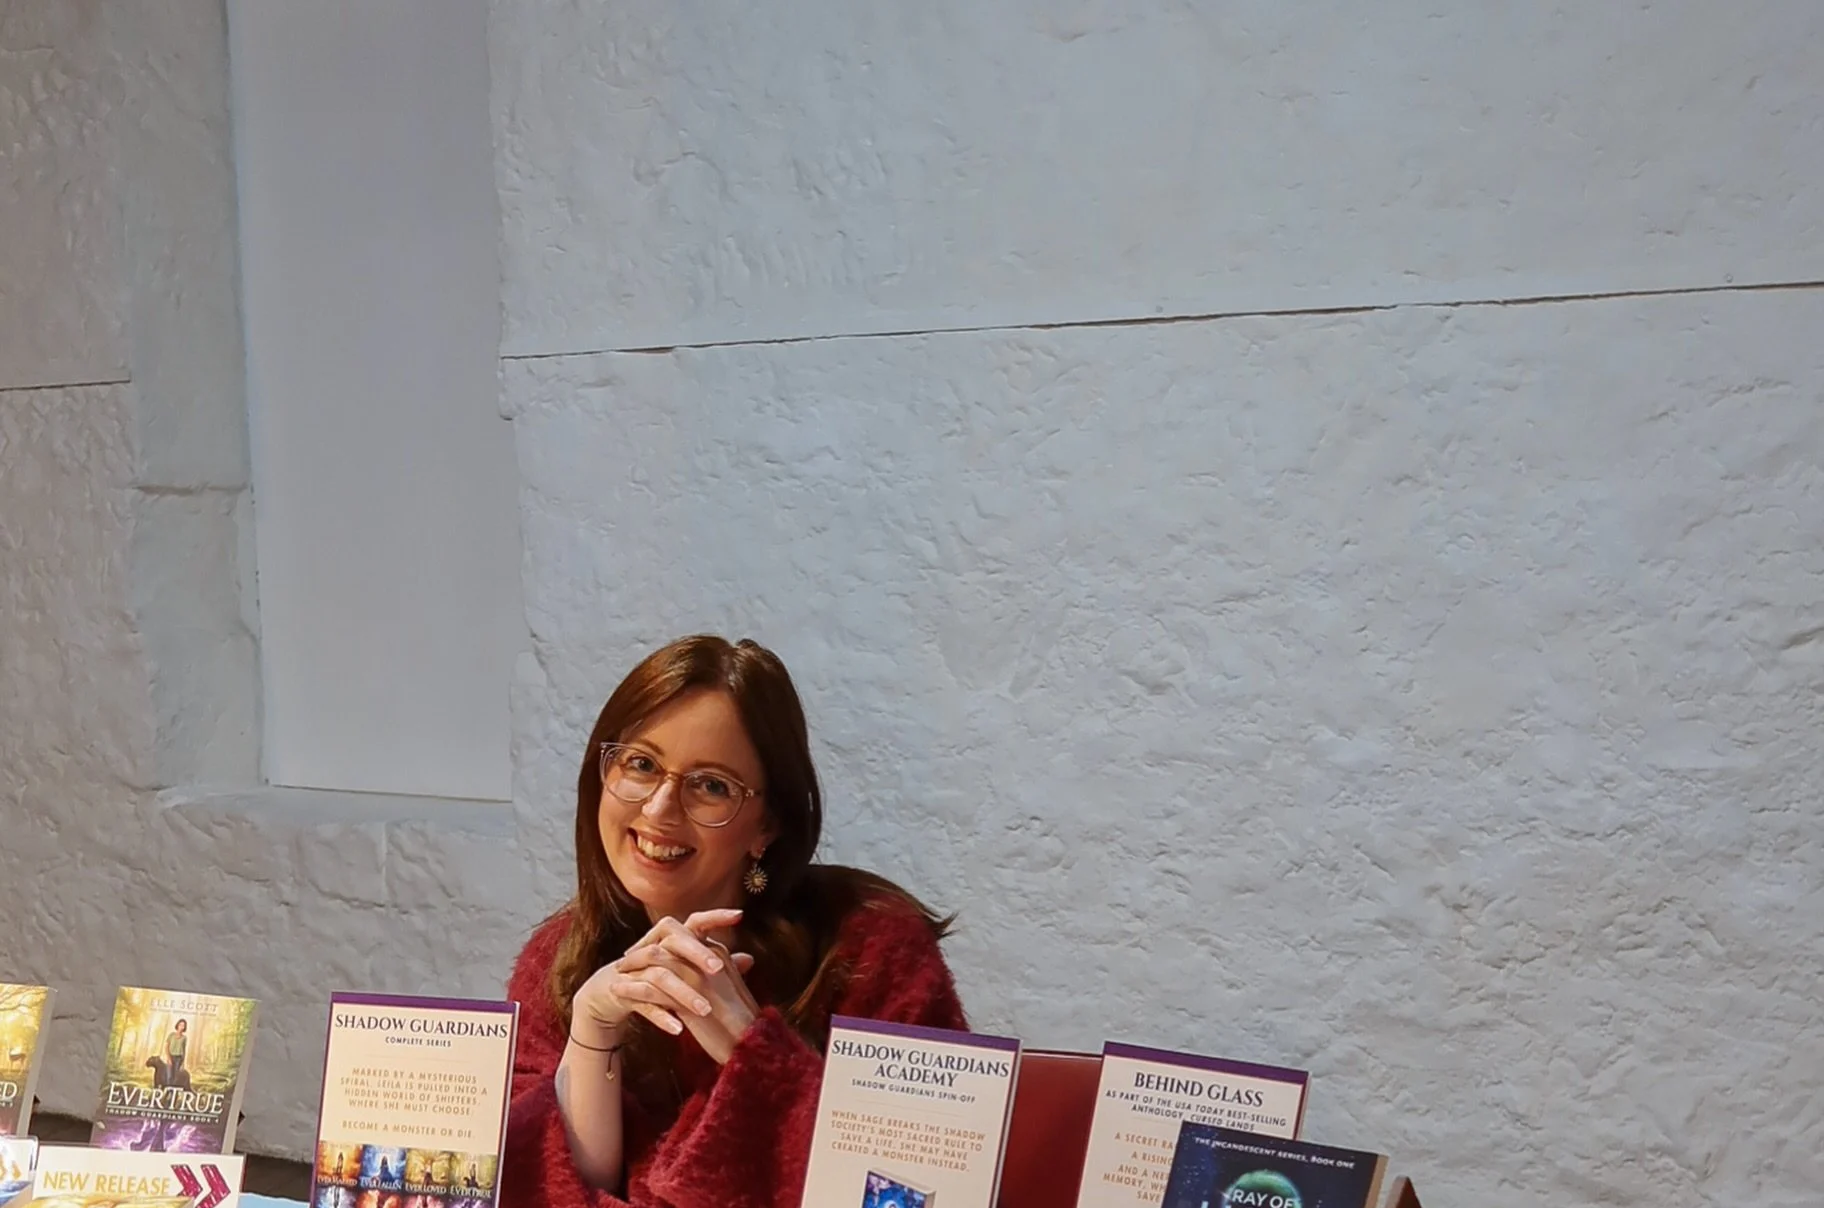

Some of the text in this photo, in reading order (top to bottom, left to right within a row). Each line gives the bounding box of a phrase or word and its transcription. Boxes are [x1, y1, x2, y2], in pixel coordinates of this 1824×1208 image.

[335, 1014, 508, 1038] SHADOW GUARDIANS
[386, 1036, 451, 1047] COMPLETE SERIES
[832, 1040, 1009, 1077] SHADOW GUARDIANS
[875, 1064, 958, 1087] ACADEMY
[852, 1079, 886, 1090] SHADOW
[889, 1085, 935, 1097] GUARDIANS
[1134, 1072, 1264, 1107] BEHIND GLASS
[1106, 1090, 1116, 1098] AS
[1120, 1092, 1140, 1101] PART
[1157, 1098, 1172, 1106] THE
[1175, 1101, 1191, 1110] USA
[1195, 1105, 1225, 1116] TODAY
[343, 1120, 378, 1130] BECOME
[393, 1124, 436, 1135] MONSTER
[441, 1128, 452, 1136] OR
[832, 1110, 986, 1141] WHEN SAGE BREAKS THE SHADOW
[1191, 1114, 1223, 1126] CURSED
[1227, 1120, 1255, 1131] LANDS
[832, 1121, 982, 1152] SOCIETY'S MOST SACRED RULE TO
[841, 1133, 862, 1141] SAVE
[901, 1141, 916, 1150] SHE
[921, 1145, 939, 1155] MAY
[944, 1149, 968, 1160] HAVE
[832, 1141, 868, 1154] CREATED
[873, 1148, 878, 1156] A
[882, 1150, 924, 1163] MONSTER
[1195, 1137, 1210, 1145] THE
[1211, 1139, 1275, 1156] INCANDESCENT
[1311, 1156, 1334, 1166] BOOK
[1337, 1160, 1355, 1169] ONE
[44, 1170, 170, 1195] NEW RELEASE
[1233, 1189, 1268, 1207] RAY
